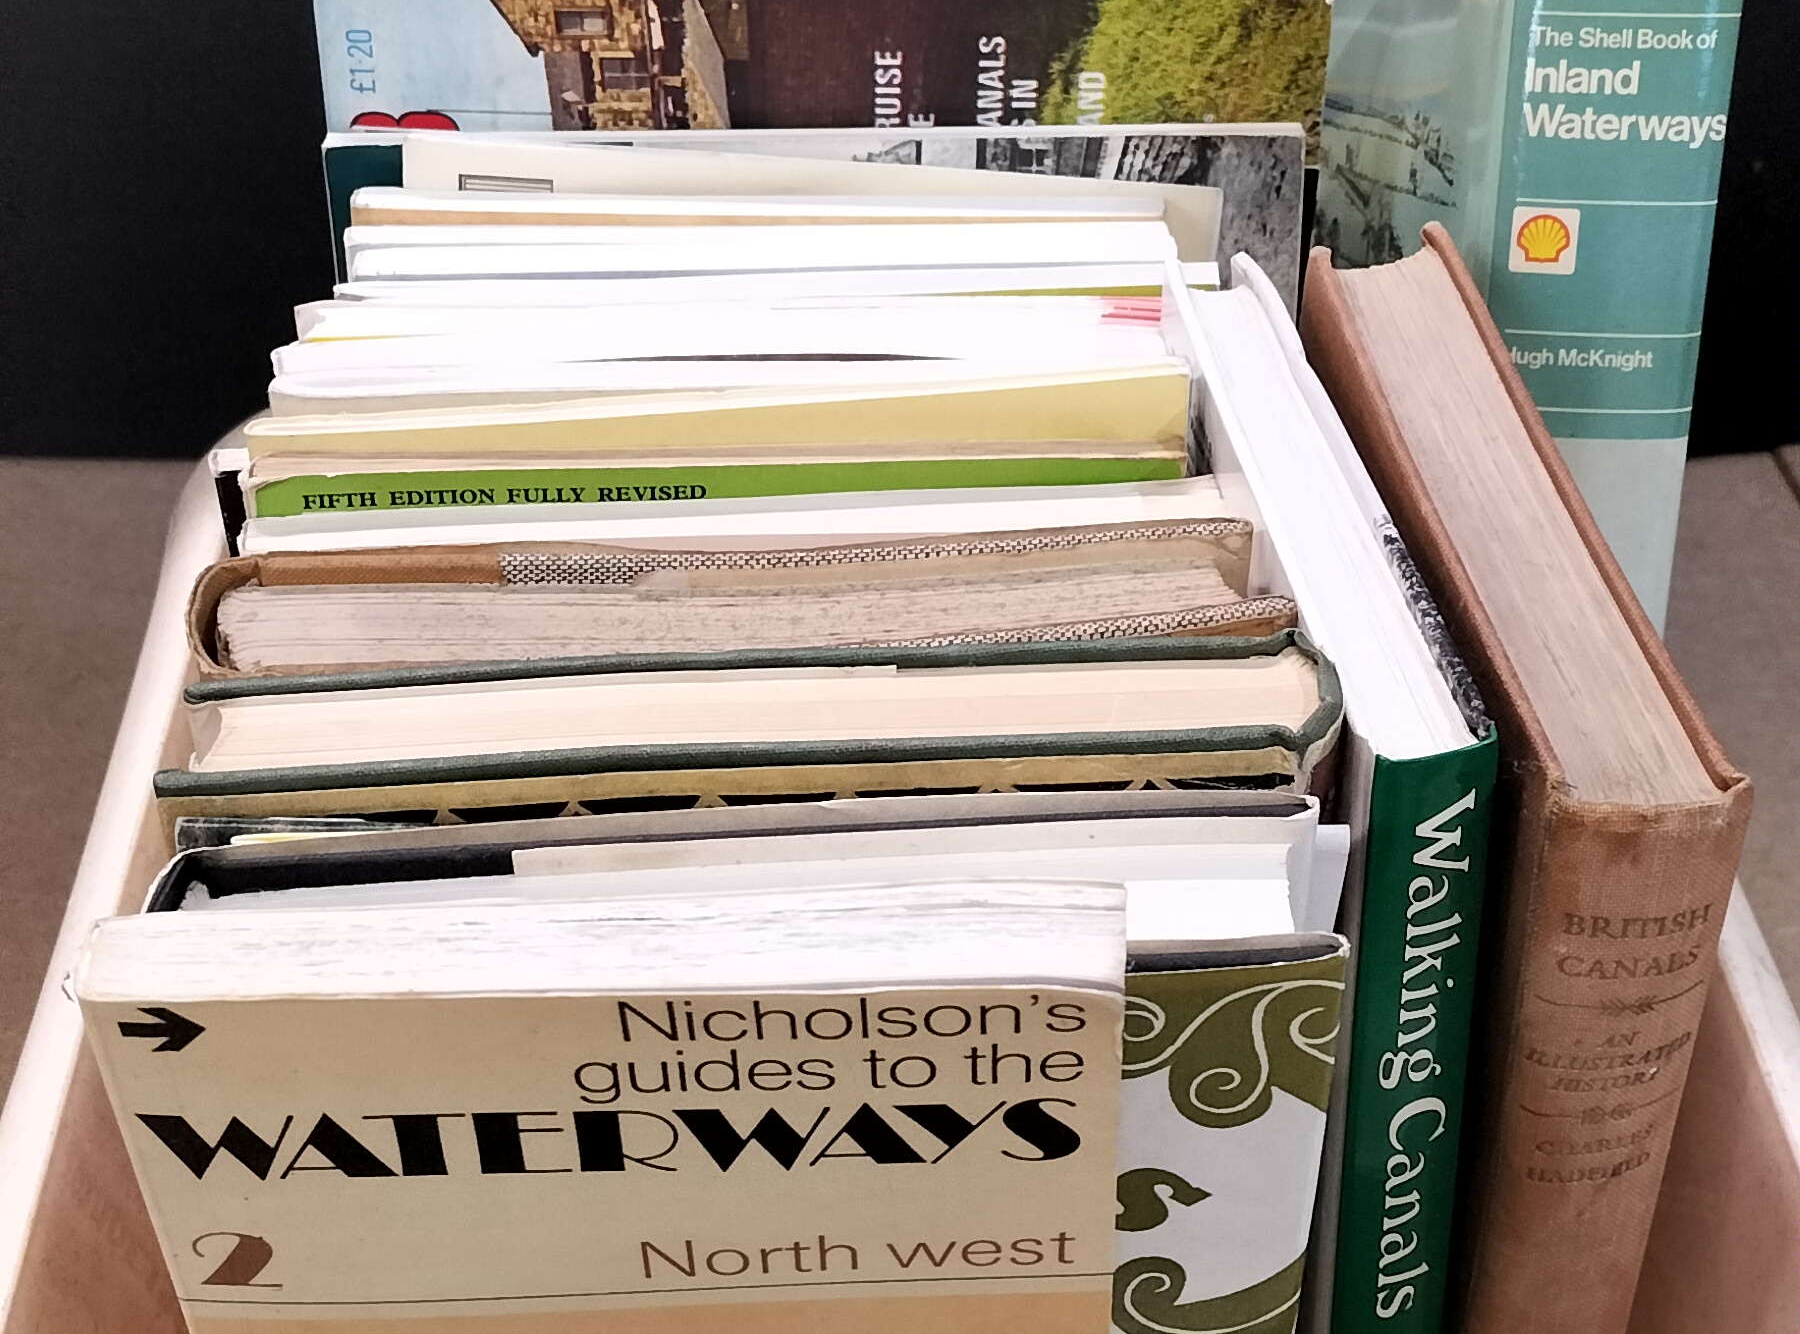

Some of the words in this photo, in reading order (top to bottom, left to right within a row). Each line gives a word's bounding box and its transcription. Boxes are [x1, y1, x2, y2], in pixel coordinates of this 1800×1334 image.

[1533, 25, 1574, 47] The
[1578, 27, 1633, 49] Shell
[1637, 28, 1693, 50] Book
[1696, 29, 1719, 49] of
[874, 50, 904, 128] RUISE
[976, 35, 1006, 127] ANALS
[1010, 78, 1038, 109] IN
[1076, 71, 1107, 126] AND
[1526, 58, 1641, 95] Inland
[1523, 102, 1727, 149] Waterways
[1557, 348, 1653, 372] McKnight
[302, 490, 378, 510] FIFTH
[389, 487, 496, 506] EDITION
[506, 486, 586, 504] FULLY
[598, 484, 708, 502] REVISED
[1378, 787, 1477, 1091] Walking
[1561, 902, 1714, 940] BRITISH
[1556, 943, 1701, 980] CANALS
[617, 994, 1087, 1042] Nicholson's
[1599, 1030, 1643, 1049] AN
[573, 1048, 837, 1104] guides
[862, 1049, 937, 1090] to
[962, 1043, 1085, 1087] the
[1523, 1031, 1692, 1071] ILLUSTRATED
[134, 1097, 1082, 1182] WATERWAYS
[1375, 1096, 1446, 1320] Canals
[192, 1231, 284, 1291] 2
[640, 1235, 859, 1279] North
[886, 1231, 1077, 1269] west
